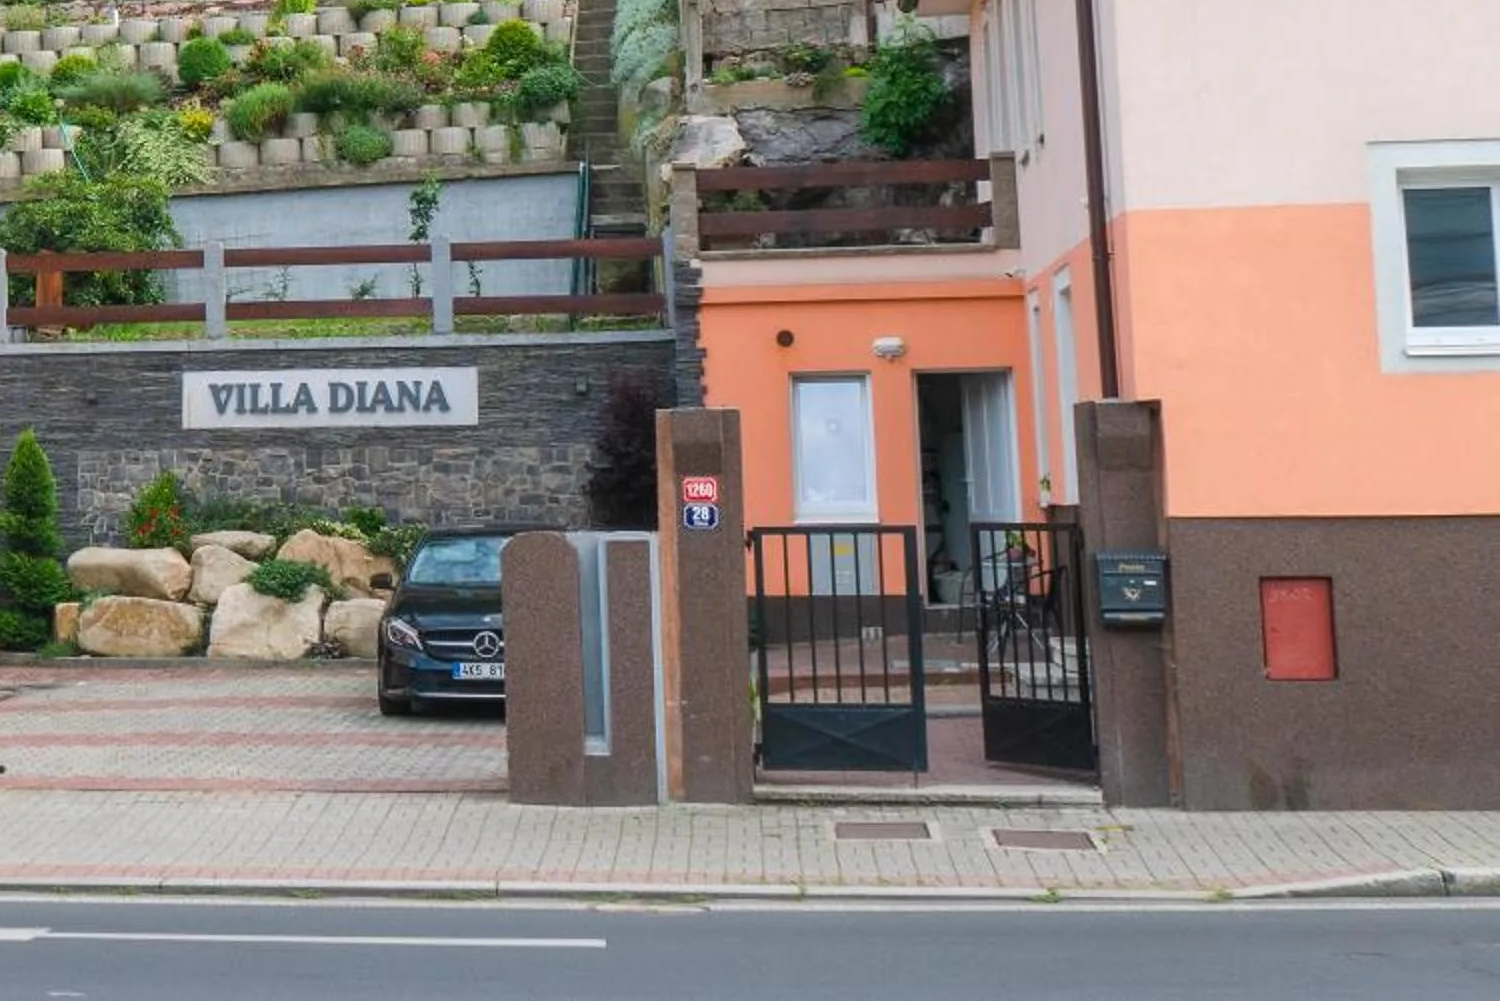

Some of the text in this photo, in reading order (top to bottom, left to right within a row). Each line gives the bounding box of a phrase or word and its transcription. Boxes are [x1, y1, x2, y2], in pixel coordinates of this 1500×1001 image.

[208, 380, 451, 414] VILLA DIANA
[692, 506, 709, 520] 28
